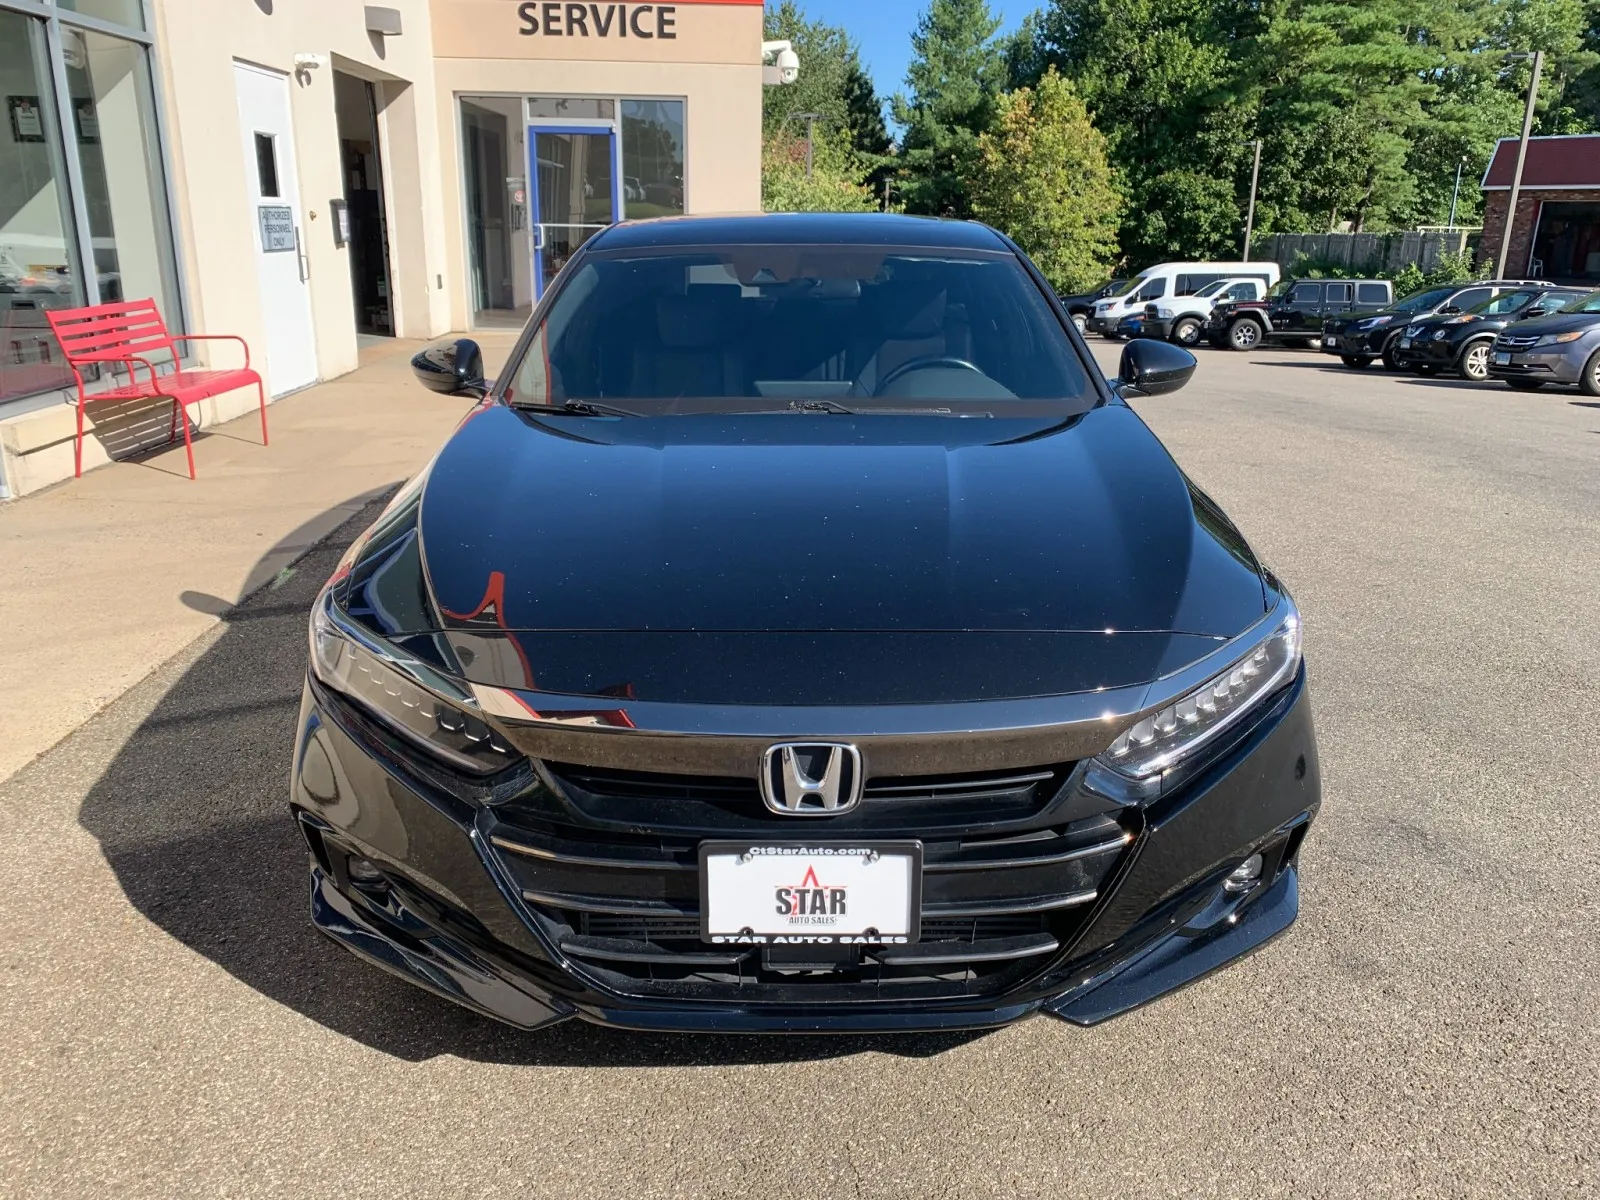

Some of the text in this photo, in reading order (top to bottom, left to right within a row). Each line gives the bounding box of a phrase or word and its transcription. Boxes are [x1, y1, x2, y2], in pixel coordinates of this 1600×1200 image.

[517, 2, 676, 39] SERVICE
[749, 846, 871, 856] CtStarAuto.com
[775, 887, 847, 915] STAR
[789, 916, 836, 925] AUTO SALES
[711, 936, 908, 944] STAR AUTO SALES
